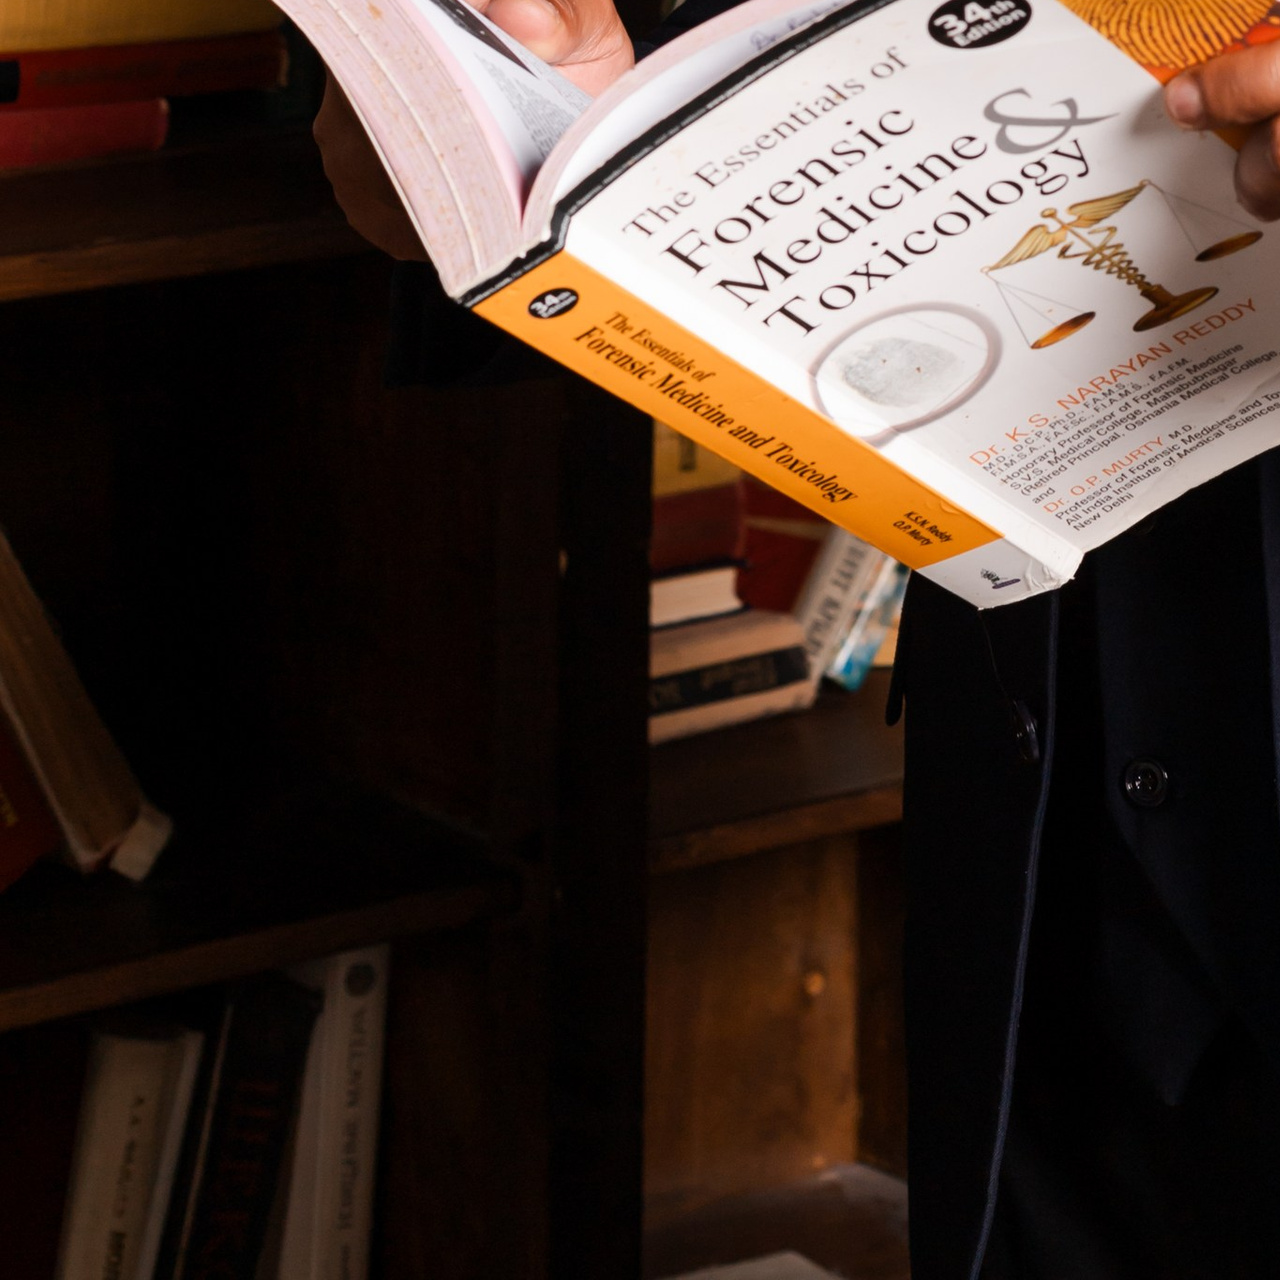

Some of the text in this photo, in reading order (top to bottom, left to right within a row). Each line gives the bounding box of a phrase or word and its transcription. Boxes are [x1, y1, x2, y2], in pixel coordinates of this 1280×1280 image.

[933, 0, 1016, 37] 34th
[952, 8, 1027, 47] Edition
[621, 45, 912, 241] The Essentials of
[659, 107, 915, 278] Forensic
[711, 132, 988, 311] Medicine
[982, 86, 1121, 155] &
[762, 137, 1092, 338] Toxicology
[604, 310, 716, 384] The Essentials of
[968, 444, 1006, 466] Dr.
[1056, 341, 1174, 411] NARAYAN
[1172, 298, 1257, 346] REDDY
[572, 325, 860, 504] Forensic Medicine and Toxicology
[1000, 343, 1244, 485] Honorary Professor of Forensic Medicine
[1020, 464, 1068, 496] (Retired
[1069, 431, 1126, 466] Principal,
[1124, 398, 1180, 432] Osmania
[1179, 369, 1230, 401] Medical
[1048, 434, 1096, 468] Medical
[1149, 357, 1238, 408] Mahabubnagar
[1055, 478, 1113, 520] Professor
[1115, 470, 1129, 484] of
[1128, 443, 1182, 475] Forensic
[1180, 413, 1238, 446] Medicine
[1237, 398, 1263, 416] and
[1031, 486, 1056, 504] and
[1043, 497, 1070, 513] Dr.
[1101, 436, 1164, 477] MURTY
[1064, 512, 1083, 527] All
[1083, 493, 1113, 519] India
[1113, 464, 1162, 496] Institute
[1163, 455, 1177, 468] of
[1176, 428, 1226, 460] Medical
[1073, 491, 1135, 532] New Delhi
[908, 528, 934, 547] Murty
[927, 522, 954, 543] Reddy
